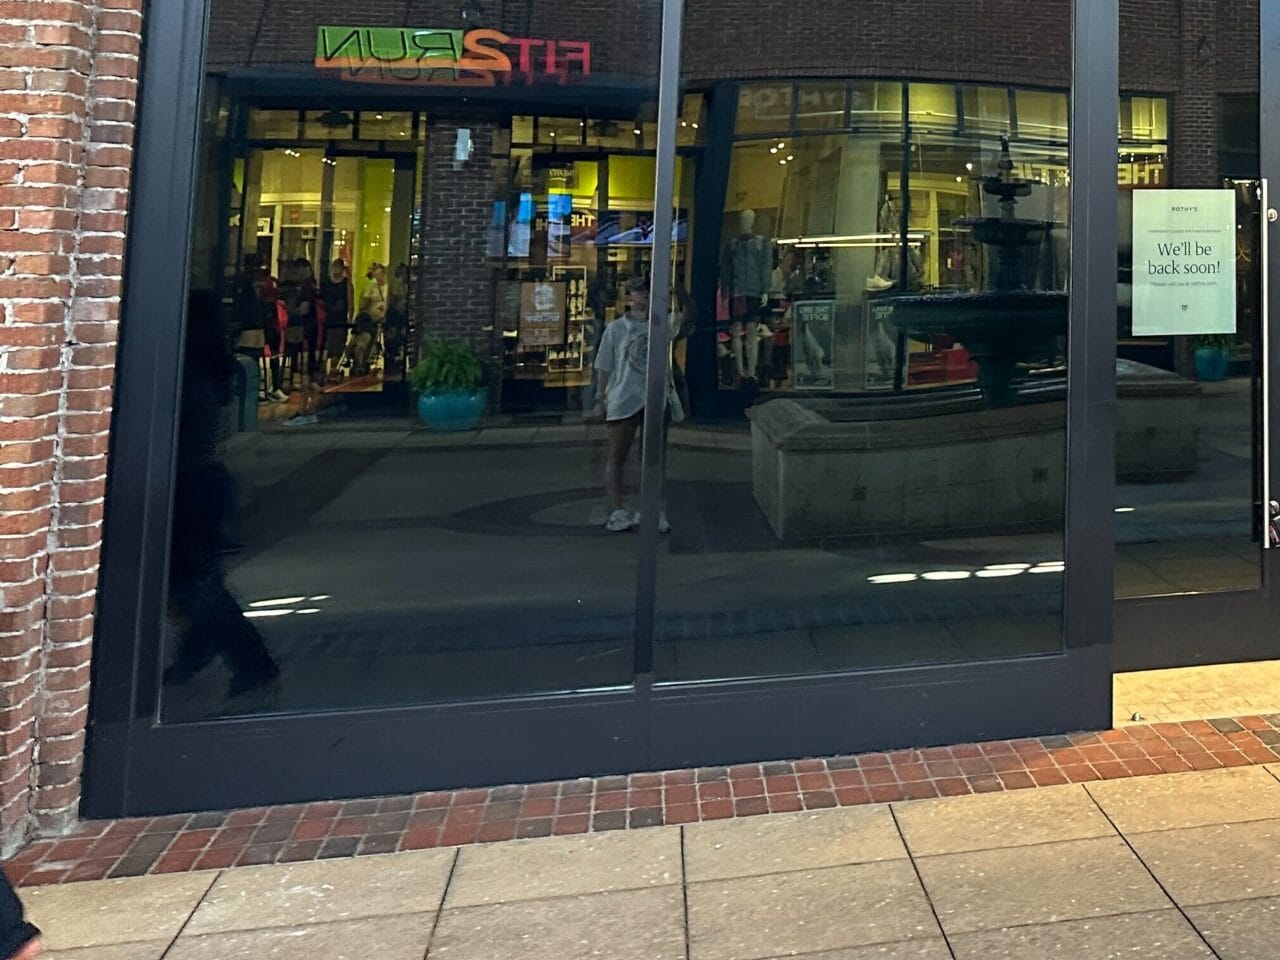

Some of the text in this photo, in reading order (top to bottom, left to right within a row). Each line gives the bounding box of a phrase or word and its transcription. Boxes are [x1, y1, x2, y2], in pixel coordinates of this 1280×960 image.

[1157, 241, 1212, 256] We'll be
[1148, 260, 1221, 275] back soon!
